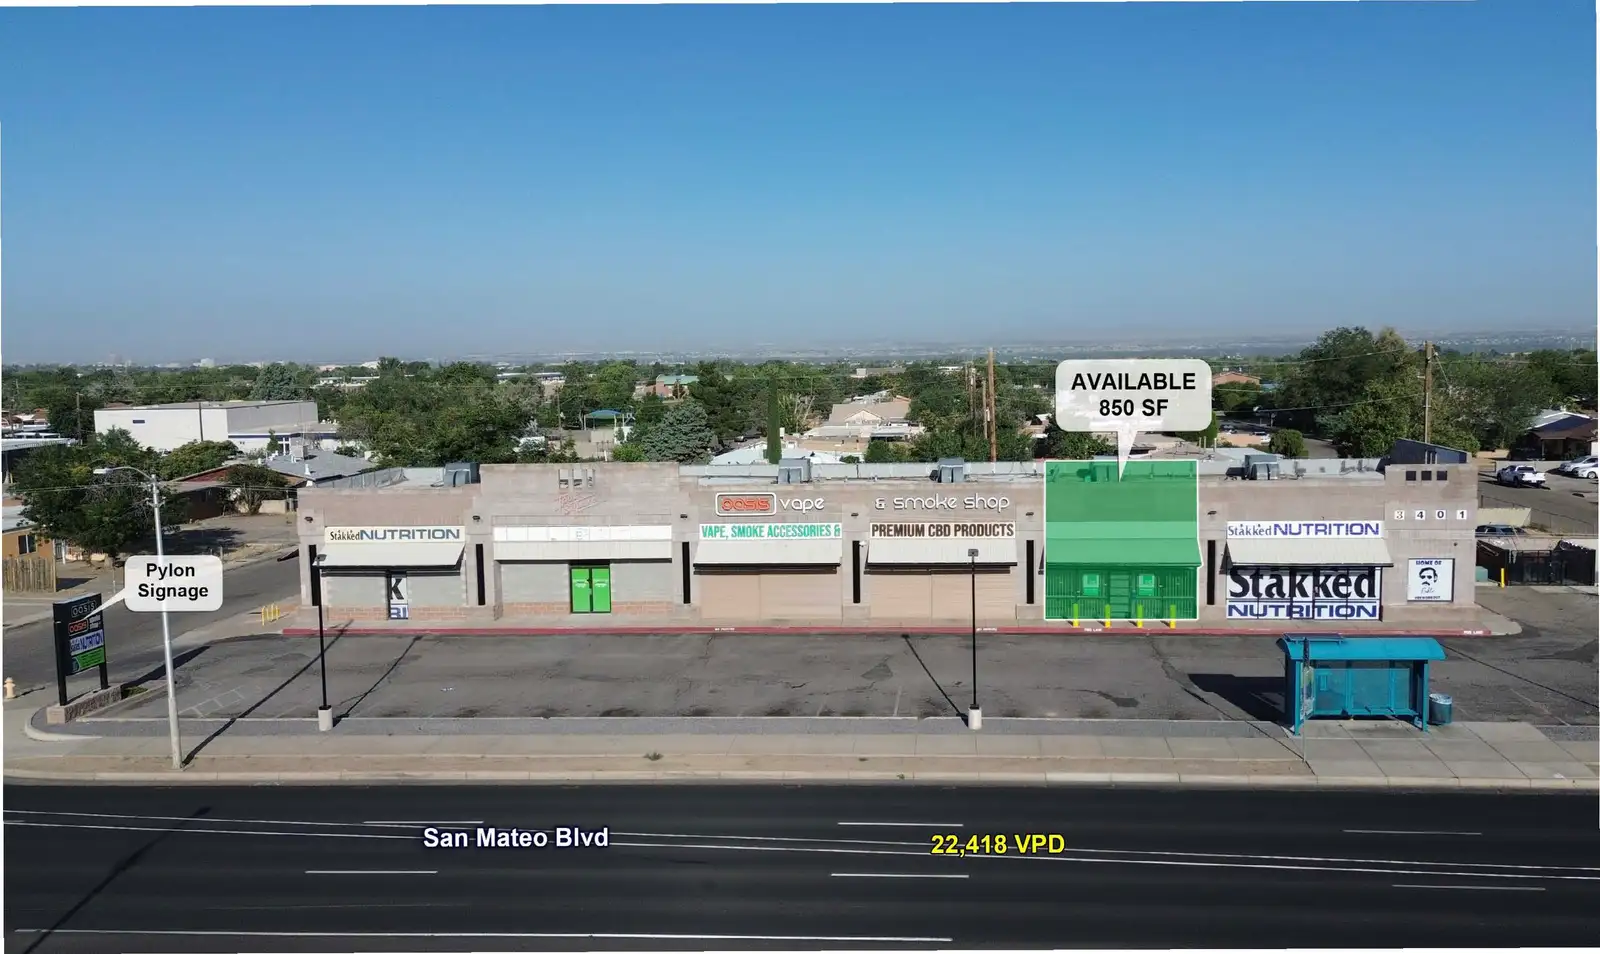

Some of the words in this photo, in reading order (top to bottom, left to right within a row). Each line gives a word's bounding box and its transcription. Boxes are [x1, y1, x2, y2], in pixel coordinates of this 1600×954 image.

[779, 497, 825, 514] vape
[875, 498, 886, 510] &
[892, 492, 958, 510] smoke
[963, 492, 1011, 514] shop
[360, 528, 460, 541] NUTRITION
[701, 525, 729, 540] VAPE,
[730, 524, 764, 539] SMOKE
[766, 523, 832, 538] ACCESSORIES
[871, 523, 925, 538] PREMIUM
[927, 523, 951, 537] CBD
[953, 523, 1015, 537] PRODUCTS
[1273, 522, 1380, 536] NUTRITION
[1227, 604, 1377, 618] NUTRITION
